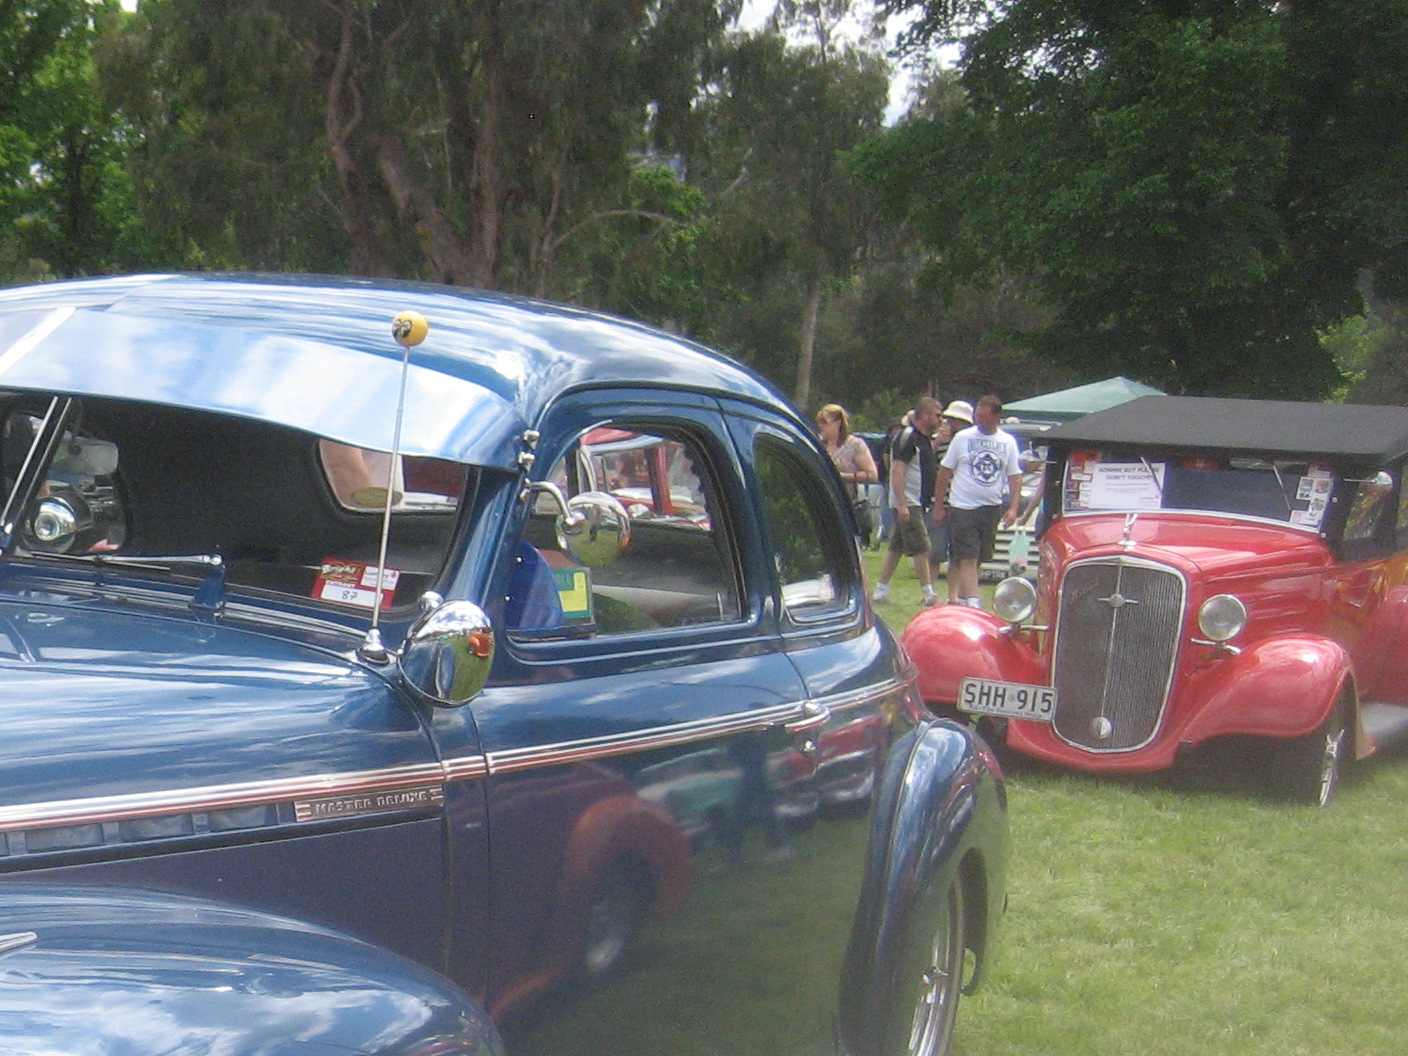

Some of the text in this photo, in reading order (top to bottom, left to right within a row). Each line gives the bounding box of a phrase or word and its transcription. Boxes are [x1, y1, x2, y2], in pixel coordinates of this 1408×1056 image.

[341, 590, 358, 600] 87
[964, 683, 1007, 708] SHH
[1016, 689, 1054, 713] 915
[315, 790, 428, 816] MASTER DELUXE
